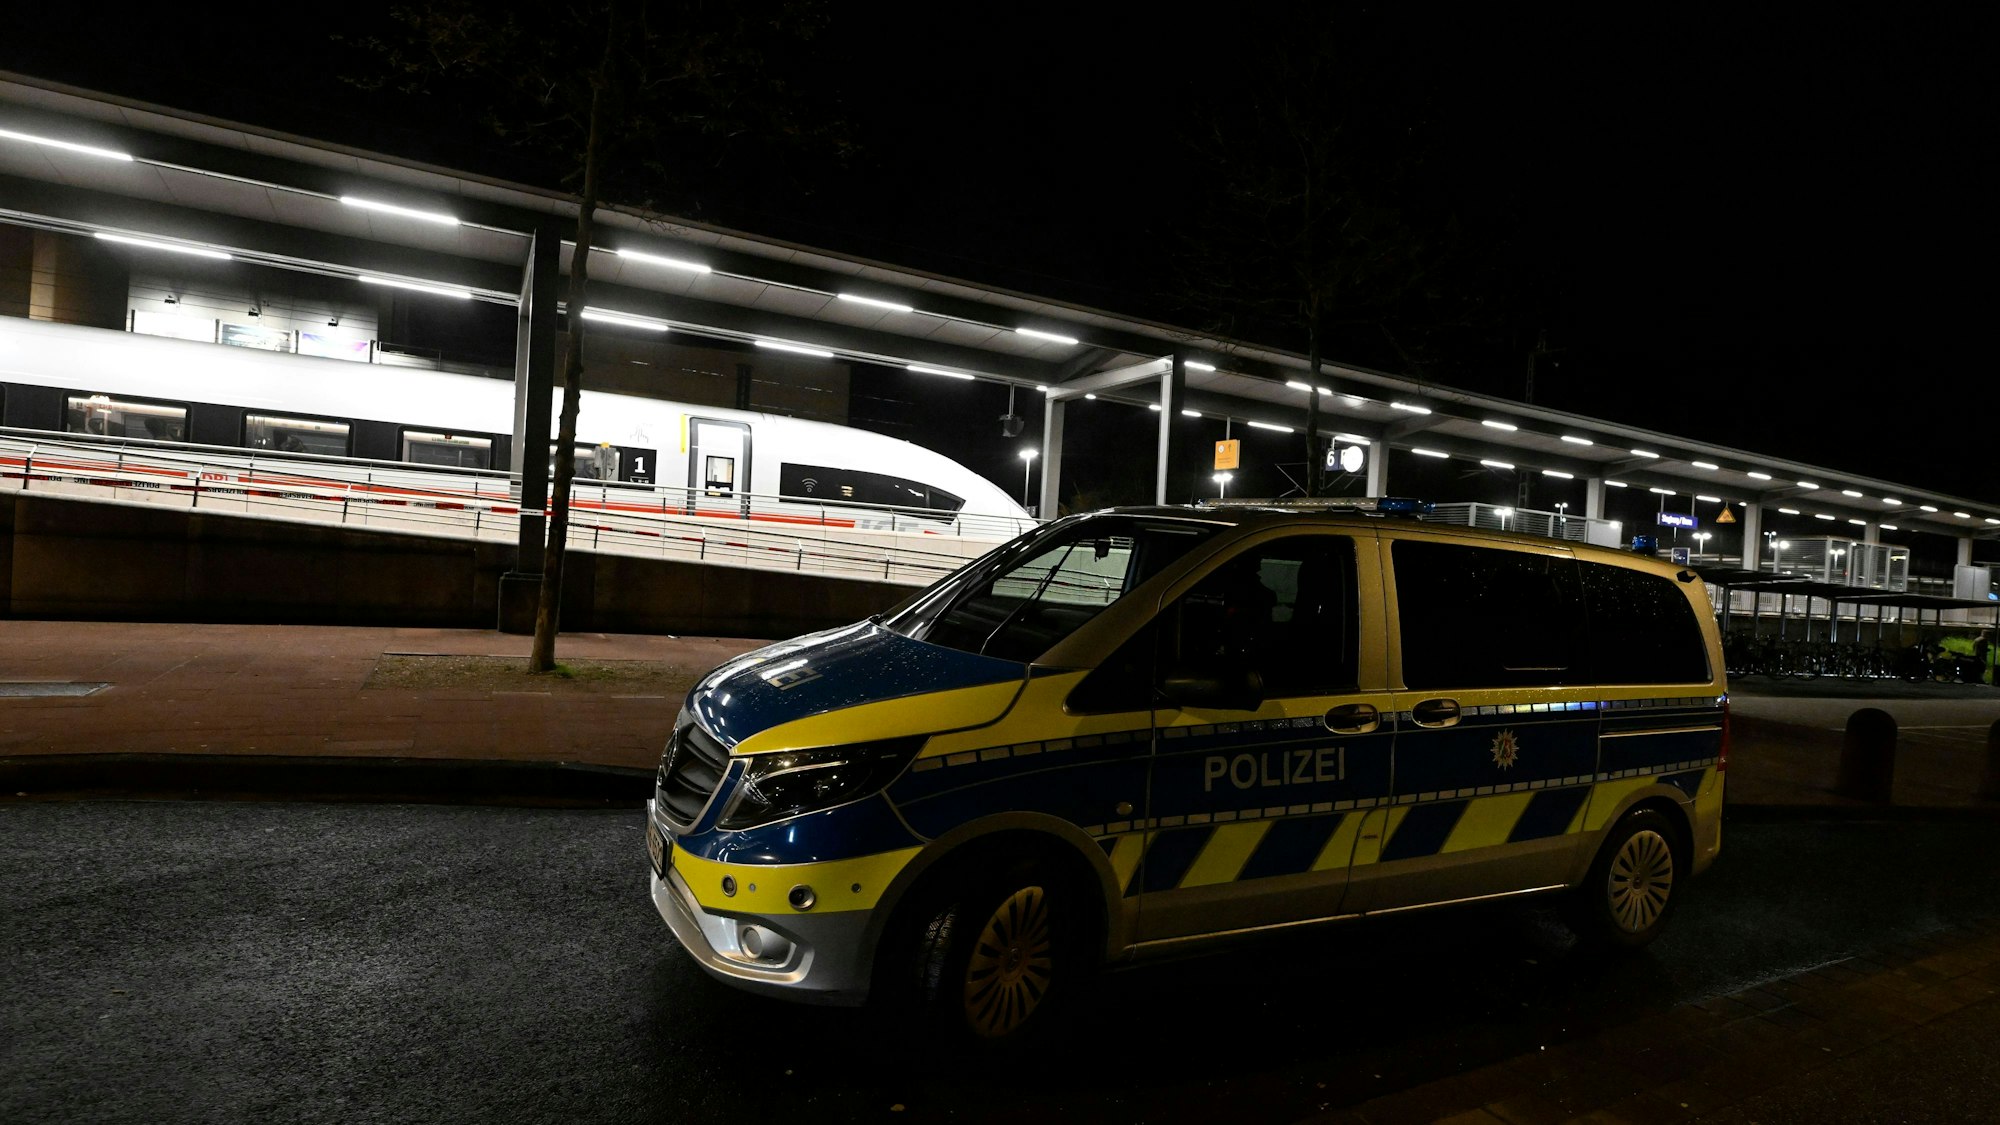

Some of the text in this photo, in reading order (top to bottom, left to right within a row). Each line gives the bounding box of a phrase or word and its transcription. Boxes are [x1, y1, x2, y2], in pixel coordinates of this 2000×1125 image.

[634, 456, 646, 474] 1
[1327, 450, 1335, 467] 6
[1203, 747, 1345, 792] POLIZEI
